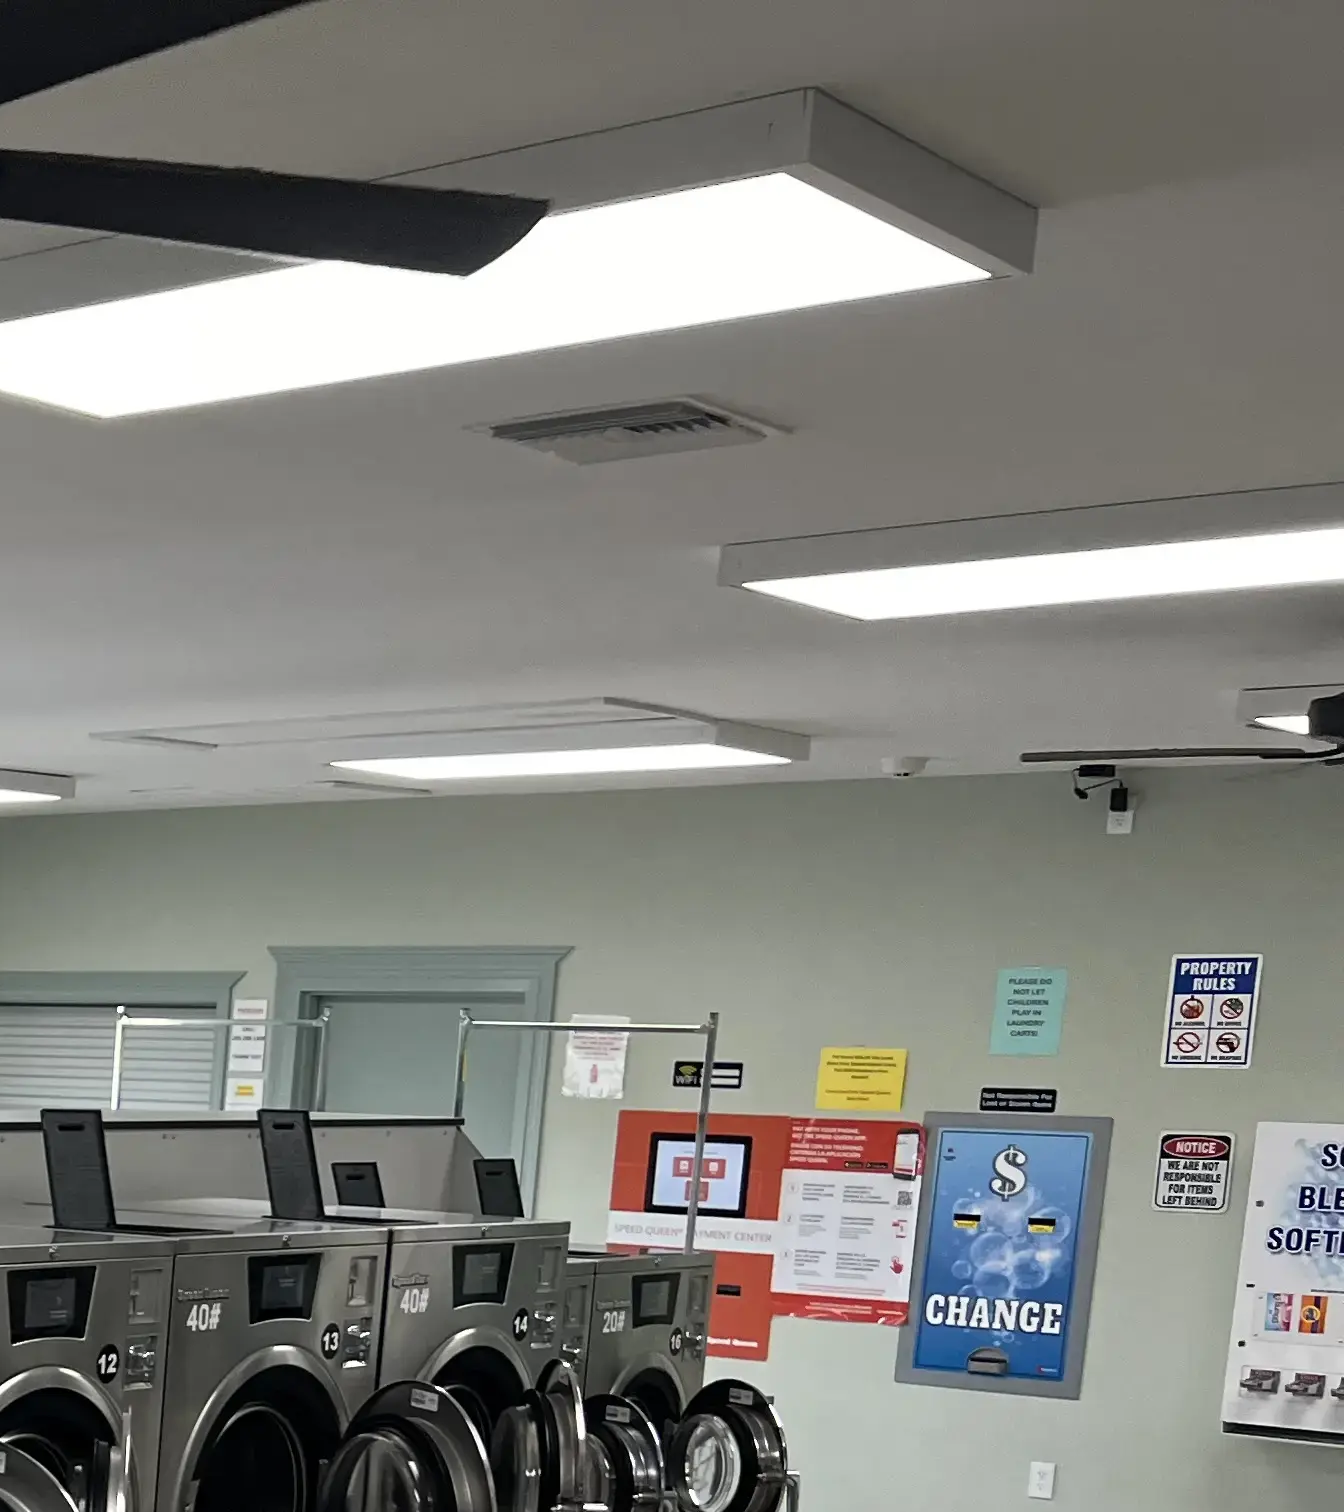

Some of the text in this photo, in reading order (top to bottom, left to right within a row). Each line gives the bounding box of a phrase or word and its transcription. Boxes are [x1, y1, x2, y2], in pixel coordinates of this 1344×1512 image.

[1180, 961, 1252, 975] PROPERTY
[1193, 977, 1236, 991] RULES
[1175, 1141, 1217, 1154] NOTICE
[1321, 1143, 1344, 1169] S
[1168, 1160, 1220, 1171] WE ARE NOT
[1162, 1172, 1222, 1183] RESPONSIBLE
[1168, 1183, 1214, 1194] FOR ITEMS
[1162, 1195, 1218, 1206] LEFT BEHIND
[614, 1223, 644, 1234] SPEED
[734, 1231, 773, 1243] CENTER
[400, 1288, 430, 1314] 40#
[186, 1302, 221, 1332] 40#
[602, 1310, 626, 1334] 20#
[925, 1293, 1063, 1335] CHANGE
[514, 1315, 528, 1334] 14
[323, 1331, 339, 1352] 13
[671, 1333, 682, 1350] 16
[97, 1352, 118, 1375] 12
